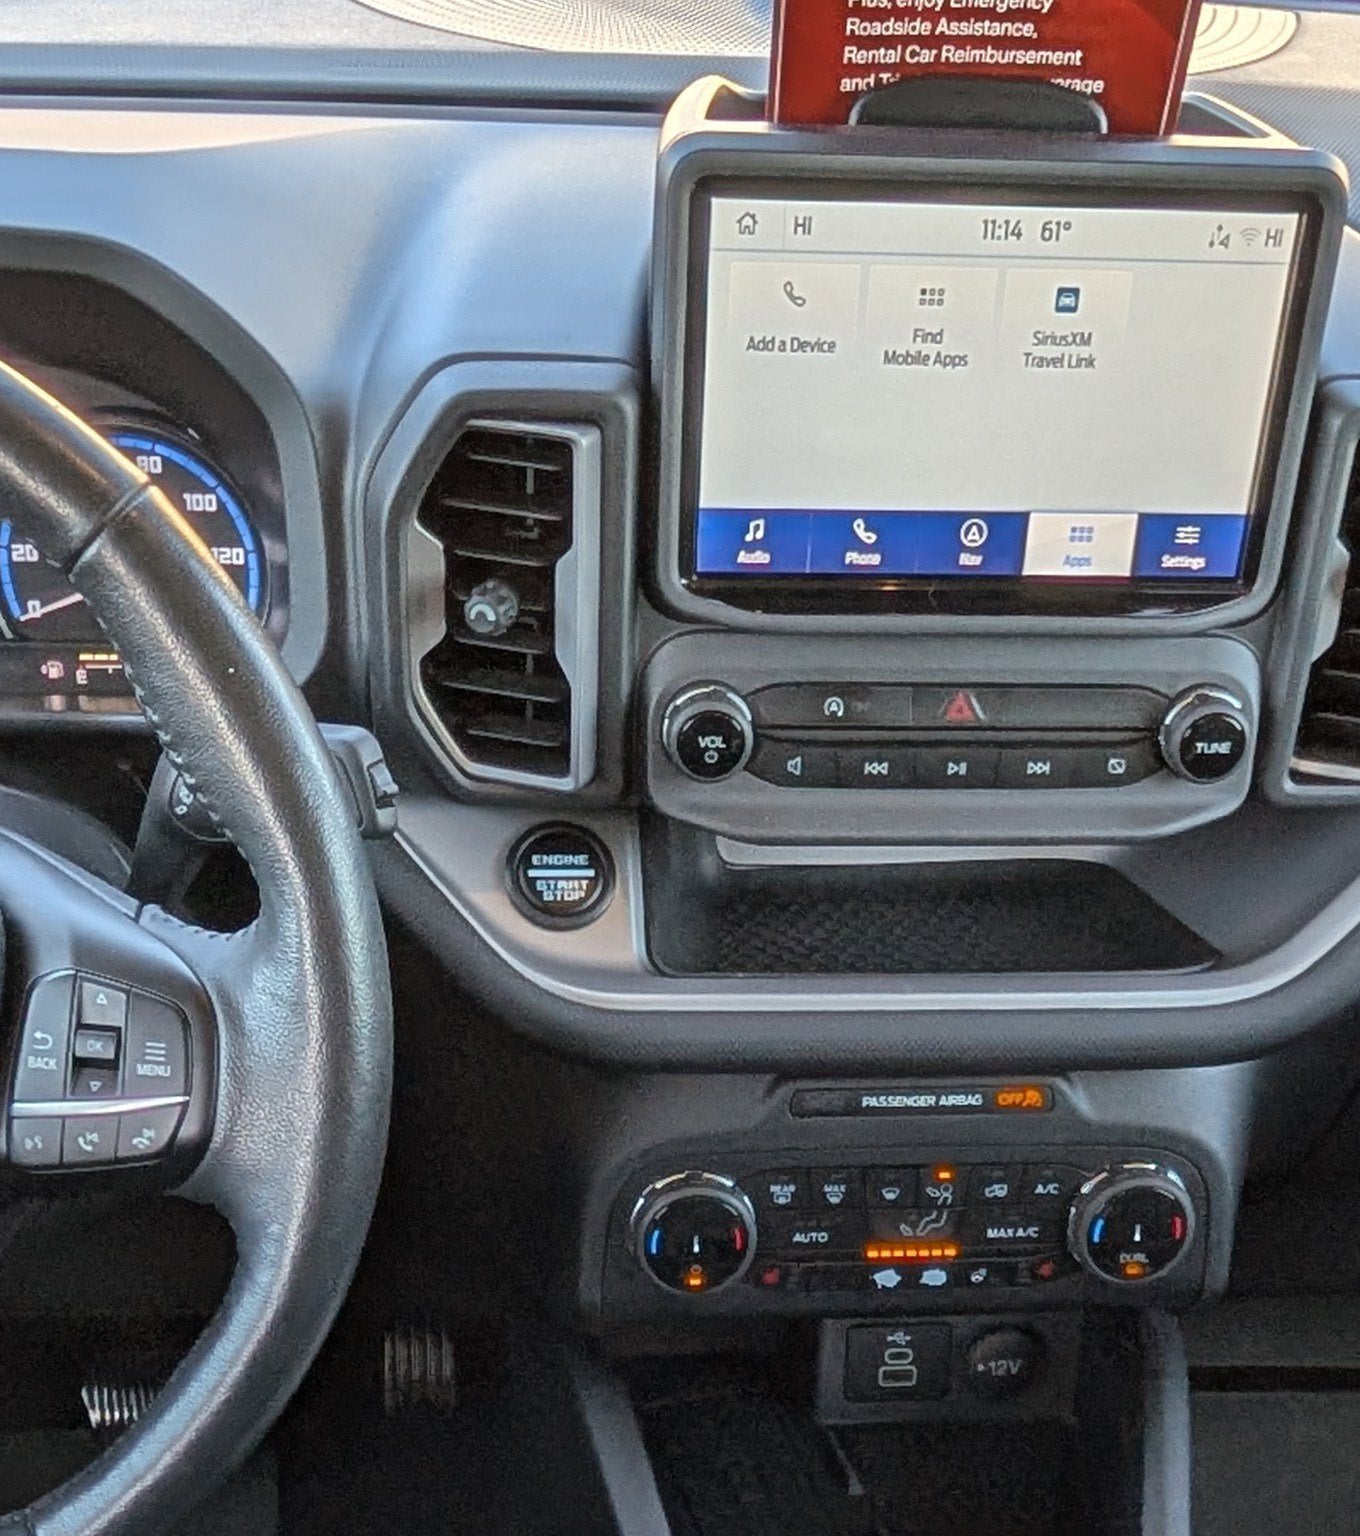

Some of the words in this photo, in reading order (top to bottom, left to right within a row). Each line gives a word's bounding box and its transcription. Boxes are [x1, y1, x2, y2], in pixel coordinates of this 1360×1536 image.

[846, 18, 931, 36] Roadside
[935, 18, 1038, 39] Assistance,
[843, 46, 901, 64] Rental
[905, 47, 937, 64] Car
[941, 46, 1082, 66] Reimbursement
[839, 73, 876, 93] and
[793, 215, 812, 236] HI
[981, 218, 1023, 242] 11:14
[1264, 228, 1284, 248] HI
[746, 336, 775, 352] Add
[778, 340, 786, 352] a
[790, 337, 836, 354] Device
[912, 328, 944, 345] Find
[1031, 330, 1092, 348] SiriusXM
[883, 350, 930, 367] Mobile
[933, 352, 969, 370] Apps
[1023, 352, 1065, 369] Travel
[1067, 354, 1096, 369] Link
[137, 456, 162, 474] 80
[183, 493, 217, 512] 100
[11, 544, 39, 562] 20
[845, 551, 881, 565] Phone
[1062, 554, 1093, 568] Apps
[1161, 555, 1206, 570] Settings
[27, 600, 41, 618] 0
[698, 735, 727, 748] VOL
[1195, 741, 1232, 754] TUNE
[531, 854, 590, 866] ENGINE
[536, 880, 589, 891] START
[542, 891, 586, 901] STOP
[87, 1040, 104, 1052] OK
[27, 1056, 57, 1070] BACK
[136, 1064, 171, 1077] MENU
[862, 1095, 936, 1108] PASSENGER
[939, 1094, 983, 1106] AIRBAG
[997, 1093, 1023, 1106] OFF
[1034, 1184, 1060, 1195] A/C
[792, 1232, 829, 1243] AUTO
[986, 1228, 1015, 1239] MAX
[1016, 1227, 1039, 1238] A/C
[988, 1359, 1023, 1377] 12V
